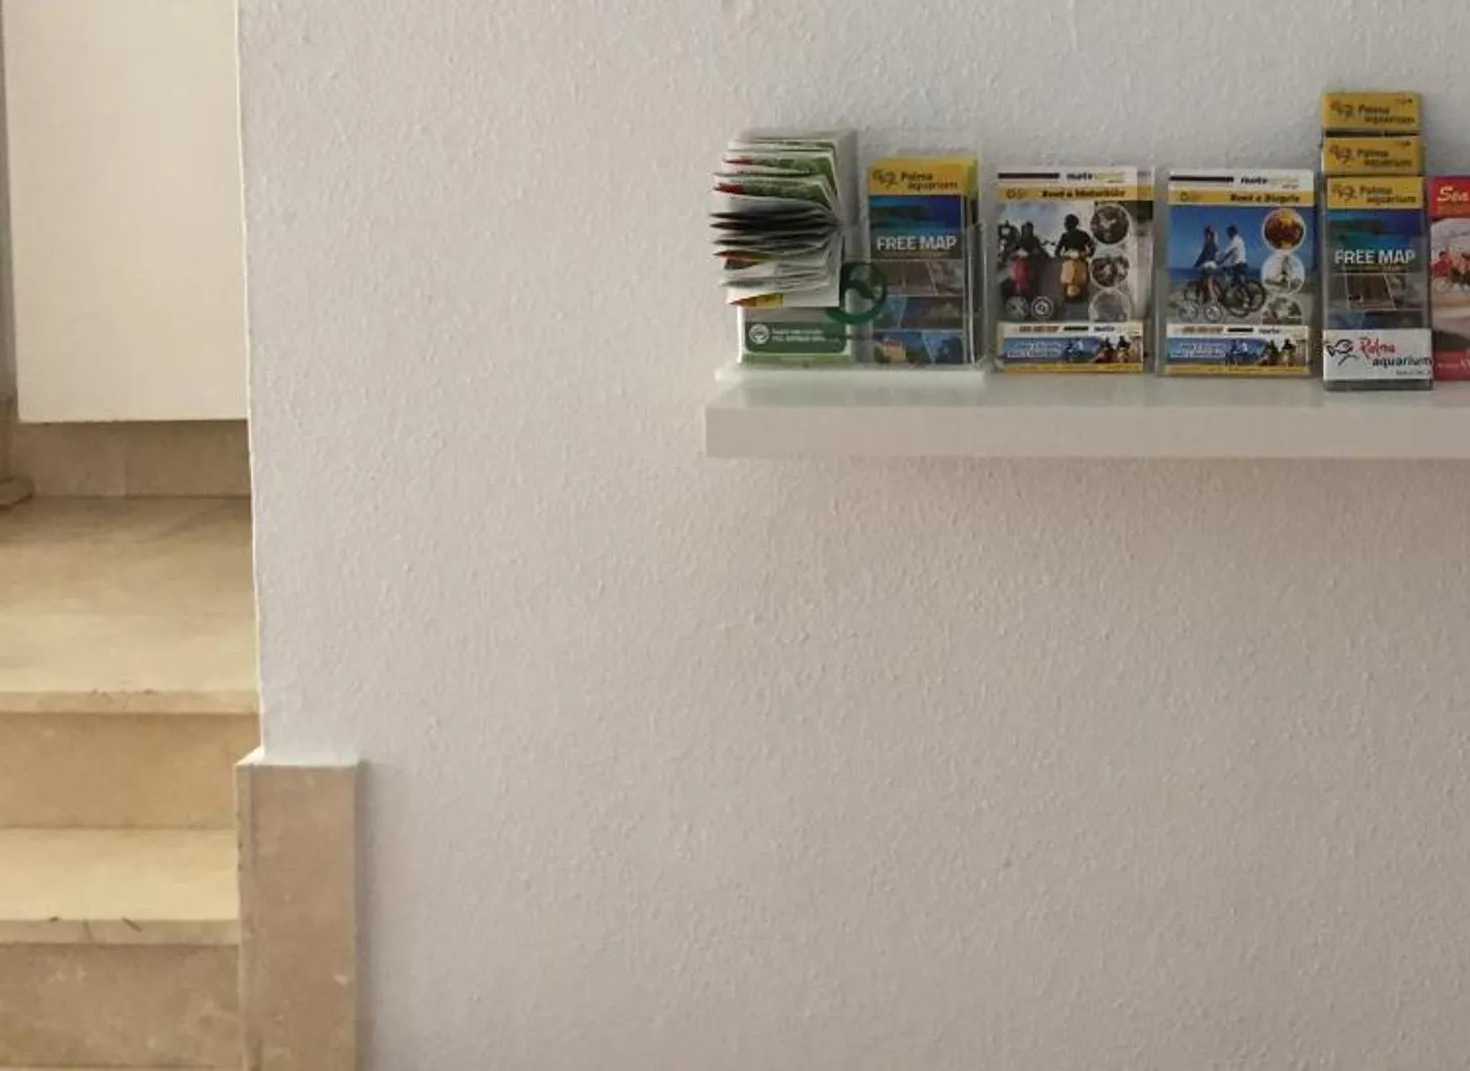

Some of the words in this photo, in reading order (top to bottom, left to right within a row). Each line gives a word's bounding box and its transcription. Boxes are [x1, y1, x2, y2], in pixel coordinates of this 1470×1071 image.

[876, 235, 917, 251] FREE
[919, 235, 957, 251] MAP
[1334, 249, 1374, 265] FREE
[1377, 249, 1416, 265] MAP
[1371, 353, 1432, 369] aquarium
